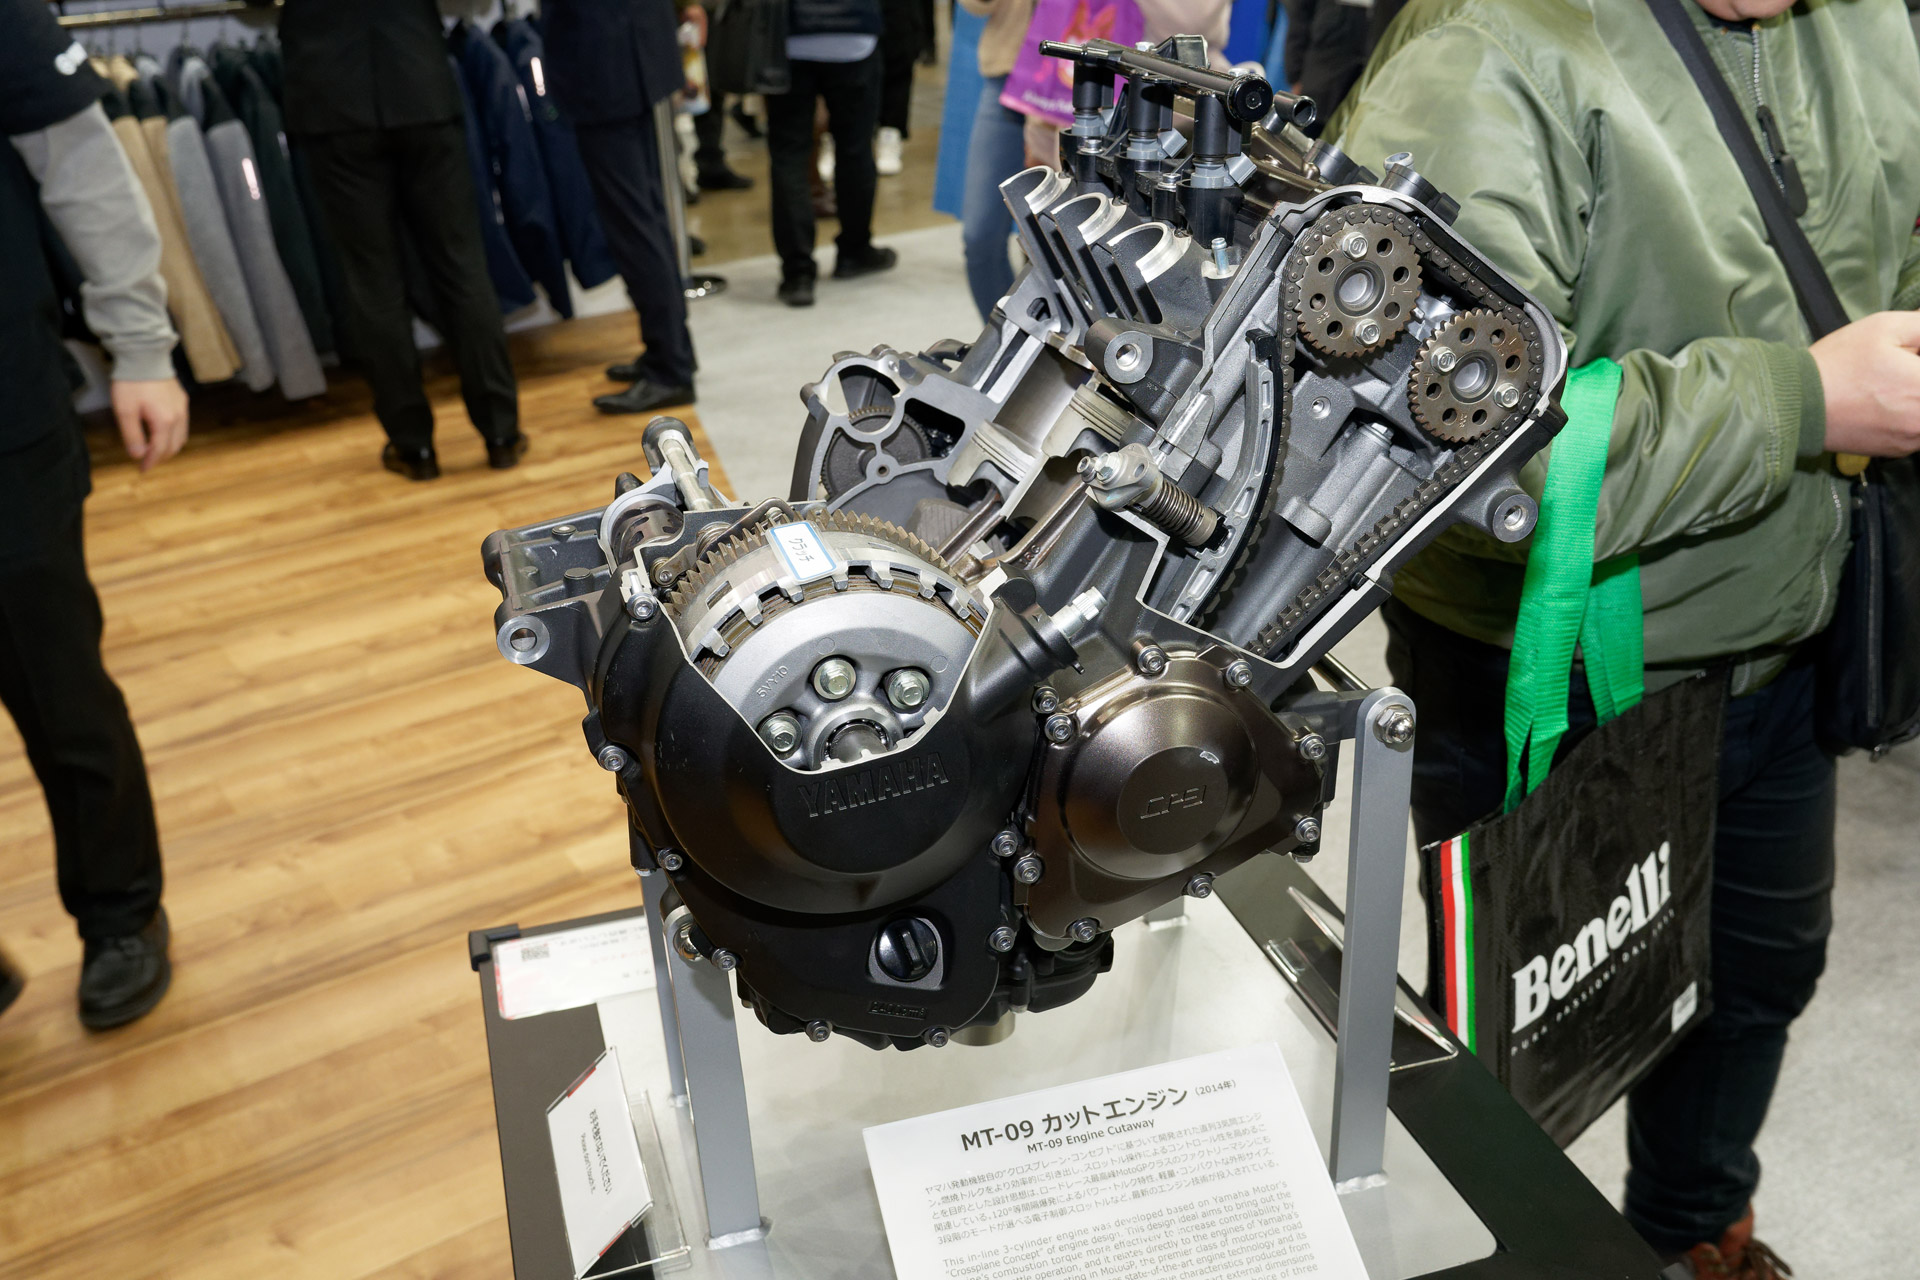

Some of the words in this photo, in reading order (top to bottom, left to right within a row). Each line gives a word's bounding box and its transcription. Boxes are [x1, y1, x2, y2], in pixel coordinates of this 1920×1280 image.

[788, 537, 815, 562] クラッチ
[756, 665, 789, 698] 5VY10
[798, 751, 950, 818] YAMAHA
[1511, 841, 1671, 1033] Benelli
[1510, 1025, 1548, 1057] PURA
[1621, 940, 1648, 963] DAL
[960, 1119, 1034, 1151] MT-09
[1041, 1087, 1188, 1135] カットエンジン
[1026, 1137, 1063, 1154] MT-09
[1065, 1129, 1105, 1145] Engine
[1107, 1118, 1154, 1136] Cutaway
[942, 1256, 965, 1268] This
[967, 1248, 1000, 1262] in-line
[1002, 1235, 1052, 1254] 3-cylinder
[1055, 1227, 1089, 1241] engine
[1091, 1222, 1112, 1232] was
[1114, 1208, 1164, 1228] developed
[1165, 1201, 1195, 1215] based
[1197, 1199, 1210, 1208] on
[1211, 1190, 1250, 1204] Yamaha
[992, 1258, 1049, 1279] combustion
[1050, 1248, 1083, 1265] torque
[1085, 1244, 1111, 1257] more
[1163, 1226, 1174, 1238] to
[1177, 1219, 1217, 1235] increase
[1218, 1204, 1280, 1225] controllability
[1282, 1201, 1294, 1210] by
[1046, 1244, 1056, 1255] of
[1058, 1237, 1089, 1252] engine
[1124, 1224, 1145, 1235] This
[1146, 1218, 1176, 1231] design
[1177, 1211, 1199, 1224] ideal
[1200, 1207, 1223, 1219] aims
[1223, 1204, 1234, 1213] to
[1234, 1198, 1259, 1210] bring
[1259, 1193, 1275, 1204] out
[1275, 1191, 1291, 1200] the
[1083, 1256, 1102, 1269] and
[1103, 1255, 1111, 1264] it
[1145, 1239, 1178, 1254] directly
[1180, 1237, 1191, 1246] to
[1192, 1233, 1209, 1243] the
[1210, 1224, 1245, 1239] engines
[1246, 1219, 1255, 1230] of
[1088, 1270, 1099, 1279] in
[1139, 1256, 1156, 1267] the
[1157, 1247, 1193, 1263] premier
[1195, 1241, 1218, 1253] class
[1219, 1235, 1229, 1248] of
[1231, 1226, 1281, 1245] motorcycle
[1282, 1220, 1303, 1232] road
[1124, 1258, 1194, 1280] state-of-the-art
[1195, 1251, 1226, 1265] engine
[1226, 1239, 1275, 1257] technology
[1277, 1233, 1294, 1245] and
[1295, 1232, 1307, 1240] its
[1179, 1258, 1244, 1279] characteristics
[1245, 1246, 1287, 1265] produced
[1288, 1242, 1311, 1253] from
[1226, 1263, 1263, 1279] external
[1264, 1252, 1315, 1271] dimensions
[1279, 1268, 1289, 1279] of
[1291, 1263, 1318, 1276] three
